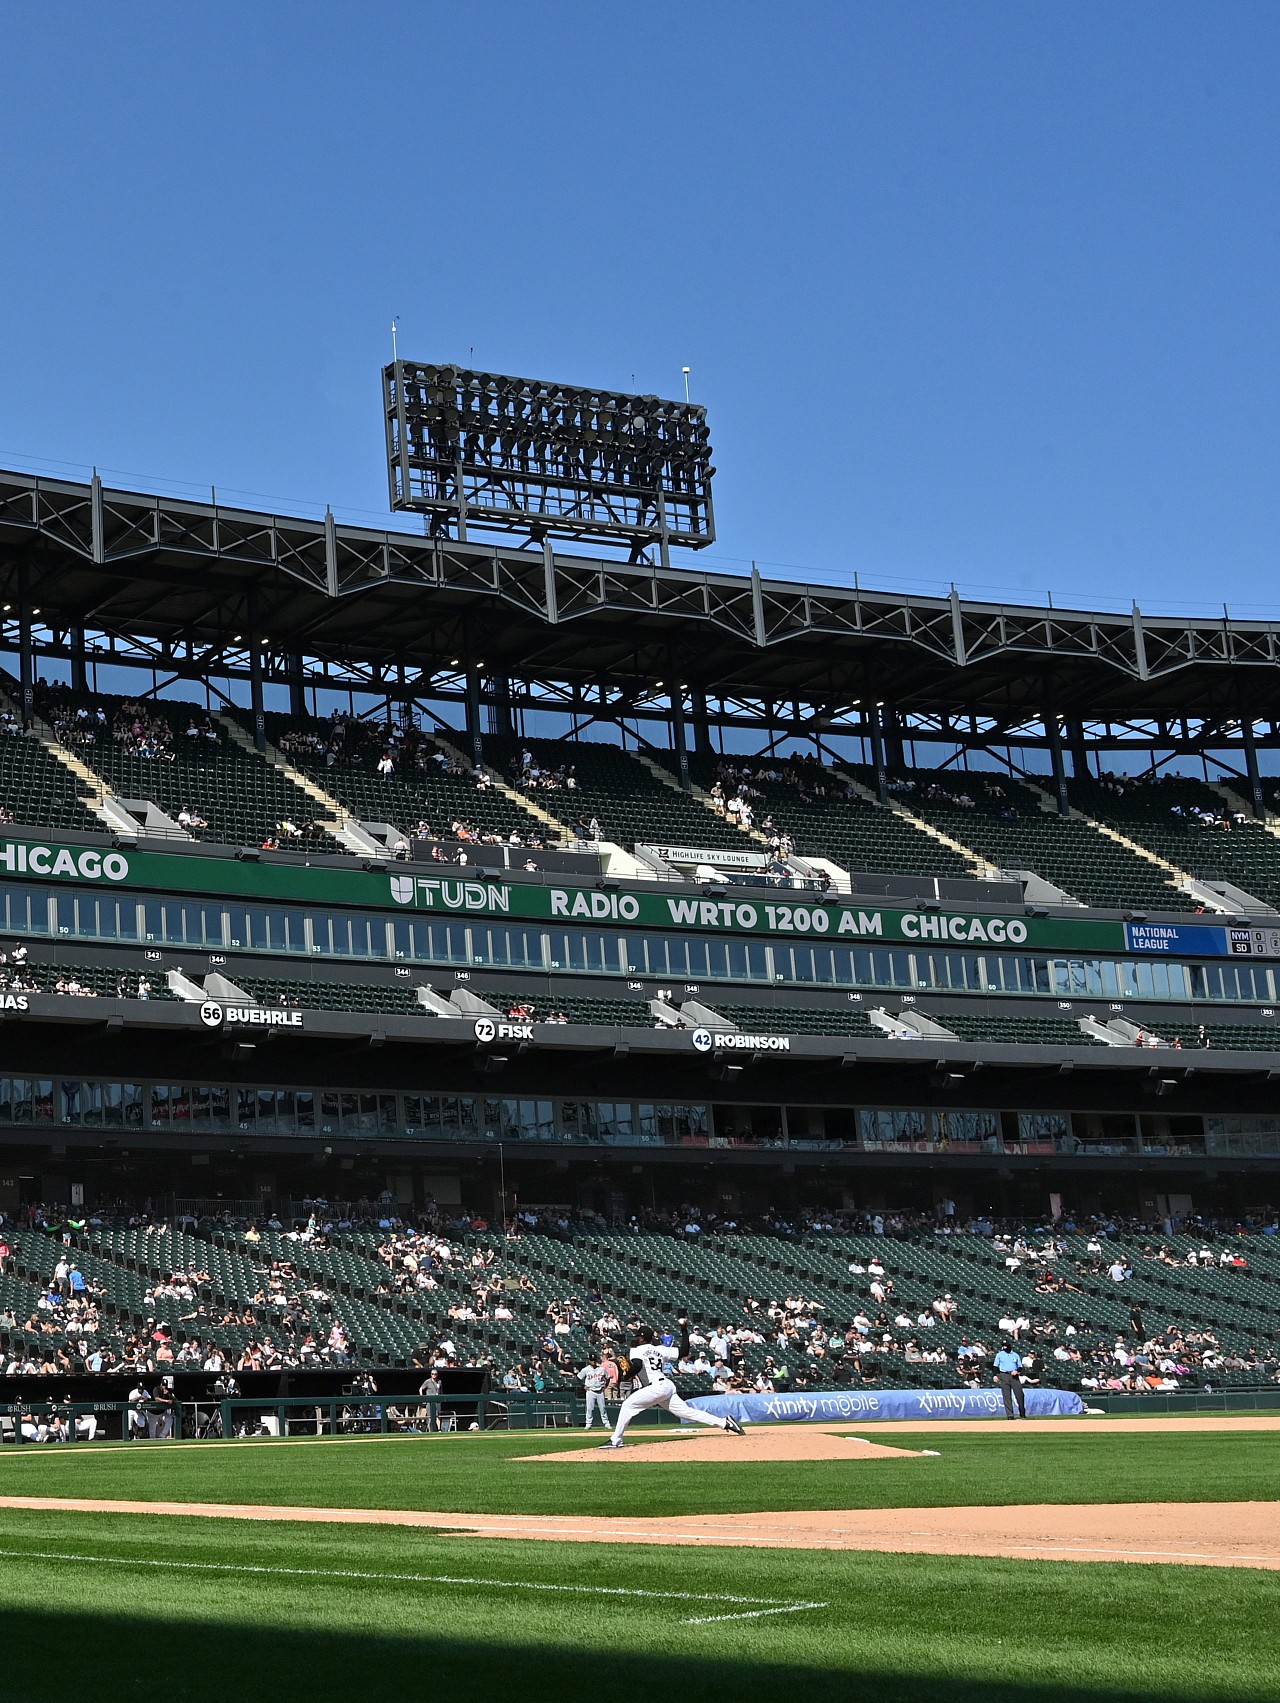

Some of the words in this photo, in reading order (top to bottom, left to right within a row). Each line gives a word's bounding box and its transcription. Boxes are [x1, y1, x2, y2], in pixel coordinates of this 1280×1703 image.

[417, 879, 510, 912] TUDN
[550, 889, 640, 921] RADIO
[667, 899, 758, 929] WRTO
[765, 906, 829, 933] 1200
[838, 911, 882, 936] AM
[900, 914, 1028, 943] CHICAGO
[59, 926, 69, 934] 50
[1132, 926, 1179, 939] NATIONAL
[1231, 931, 1249, 940] NYM
[1255, 932, 1262, 941] 0
[231, 939, 240, 947] 52
[1133, 938, 1169, 950] LEAGUE
[1236, 943, 1248, 952] SD
[1257, 944, 1263, 953] 0
[312, 945, 321, 953] 53
[395, 950, 404, 958] 54
[147, 951, 160, 960] 342
[211, 956, 224, 964] 344
[396, 968, 409, 976] 344
[203, 1007, 221, 1020] 56
[226, 1007, 303, 1026] BUEHRLE
[477, 1024, 493, 1036] 72
[498, 1024, 534, 1040] FISK
[695, 1034, 710, 1046] 42
[714, 1034, 790, 1050] ROBINSON
[649, 1357, 663, 1372] 54
[99, 1403, 117, 1411] RUSH
[765, 1396, 817, 1419] xfinity
[918, 1393, 966, 1412] xfinity
[13, 1405, 31, 1413] RUSH
